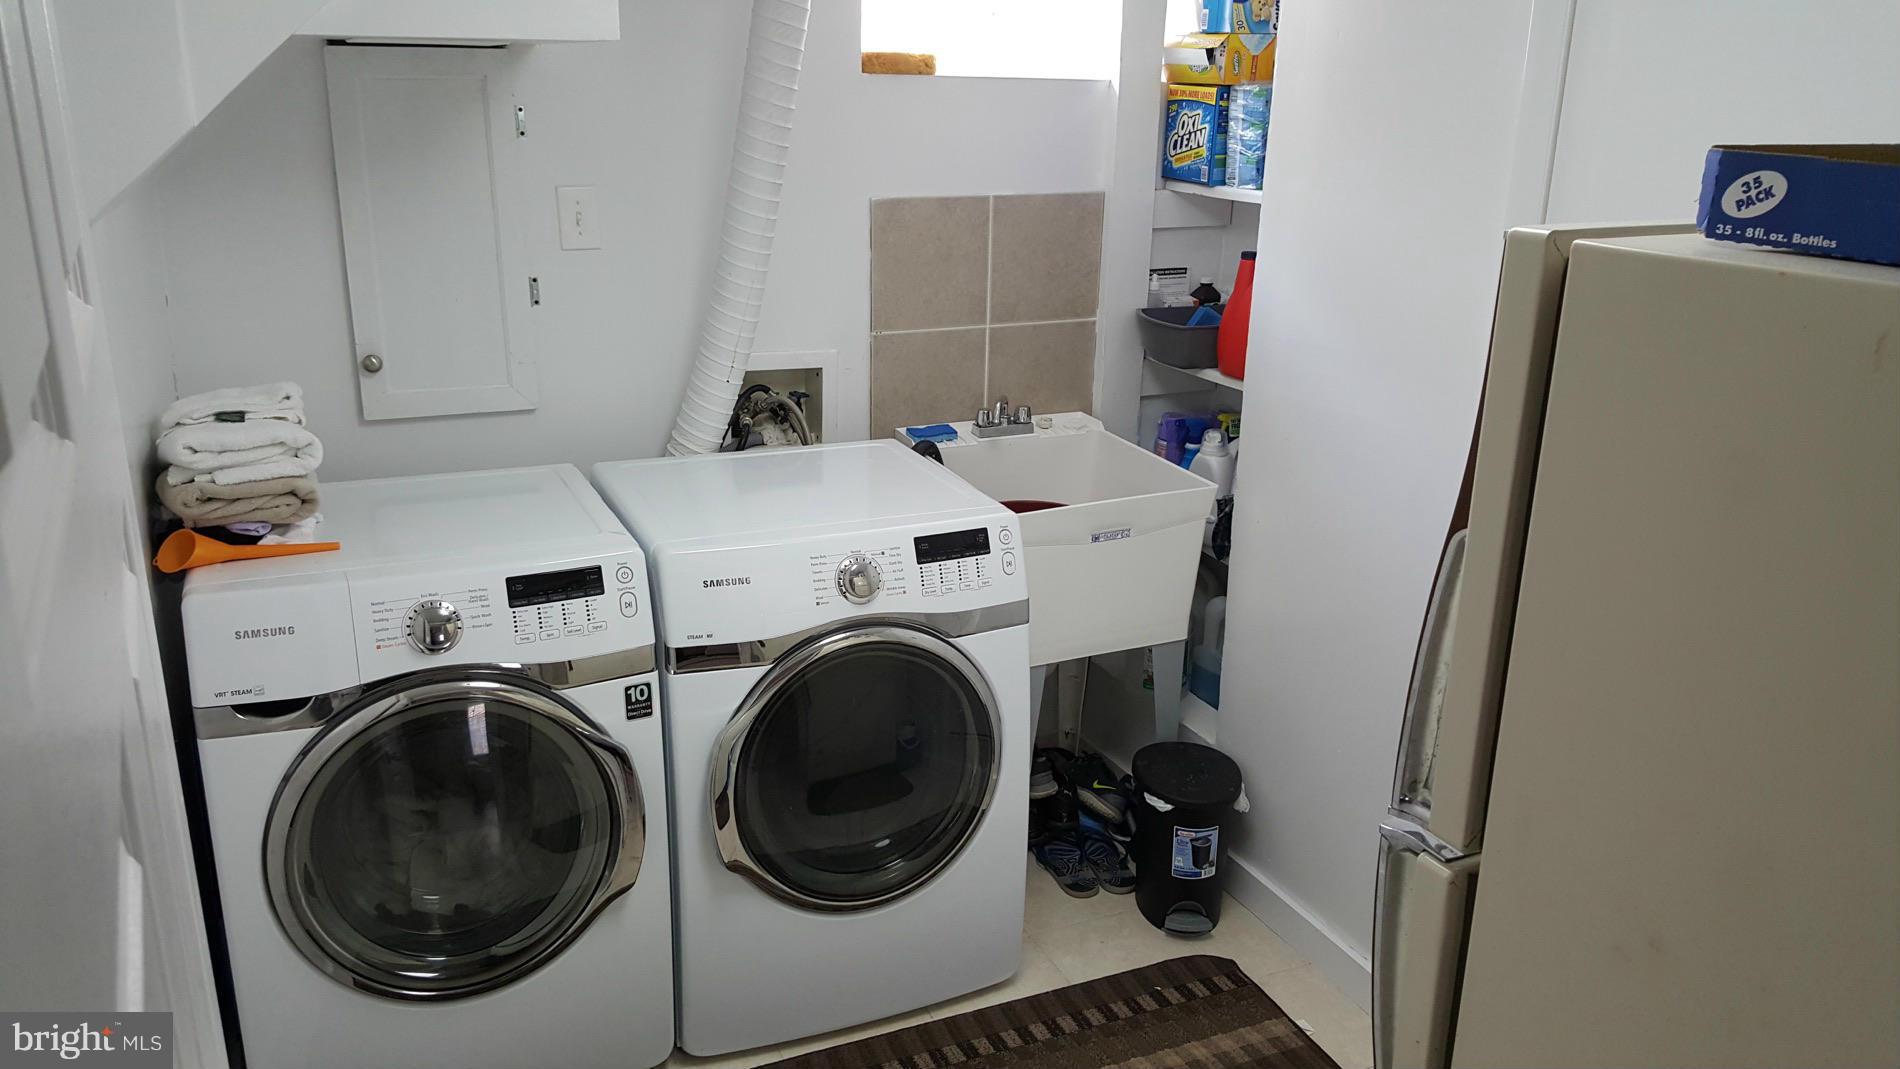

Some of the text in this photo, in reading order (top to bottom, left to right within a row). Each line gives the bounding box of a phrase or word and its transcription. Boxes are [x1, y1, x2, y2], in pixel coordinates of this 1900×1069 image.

[1236, 20, 1246, 31] 30
[1178, 112, 1201, 137] OXI
[1169, 126, 1208, 157] CLEAN
[1741, 175, 1763, 194] 35
[1734, 185, 1776, 212] PACK
[1715, 224, 1733, 235] 35
[1769, 233, 1788, 242] oz.
[1792, 233, 1837, 248] Bottles
[703, 577, 751, 588] SAMSUNG
[235, 626, 295, 640] SAMSUNG
[231, 688, 253, 697] STEAM
[627, 685, 649, 702] 10
